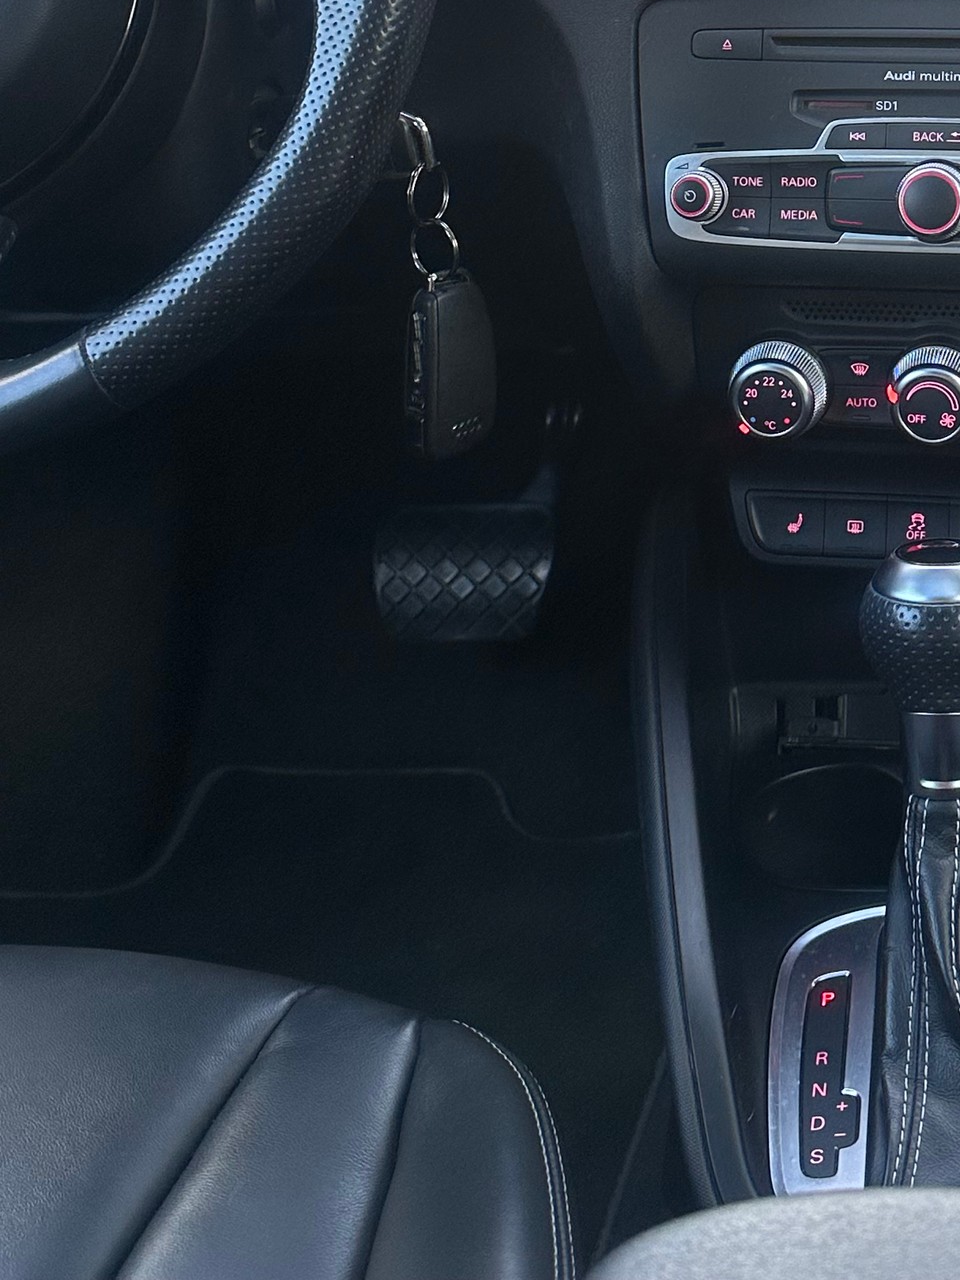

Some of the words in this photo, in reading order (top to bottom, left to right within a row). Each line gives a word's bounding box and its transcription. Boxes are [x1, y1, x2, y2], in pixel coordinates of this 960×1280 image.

[884, 71, 915, 81] Audi
[876, 101, 898, 111] SD1
[913, 132, 944, 142] BACK
[732, 177, 764, 187] TONE
[781, 177, 817, 187] RADIO
[732, 209, 756, 219] CAR
[780, 210, 818, 220] MEDIA
[763, 377, 775, 387] 22
[745, 388, 758, 398] 20
[780, 389, 793, 398] 24
[846, 397, 878, 408] AUTO
[907, 414, 927, 424] OFF
[906, 530, 926, 540] OFF
[821, 992, 835, 1007] P
[816, 1051, 828, 1066] R
[812, 1082, 827, 1098] N
[810, 1116, 825, 1132] D
[810, 1149, 824, 1165] S
